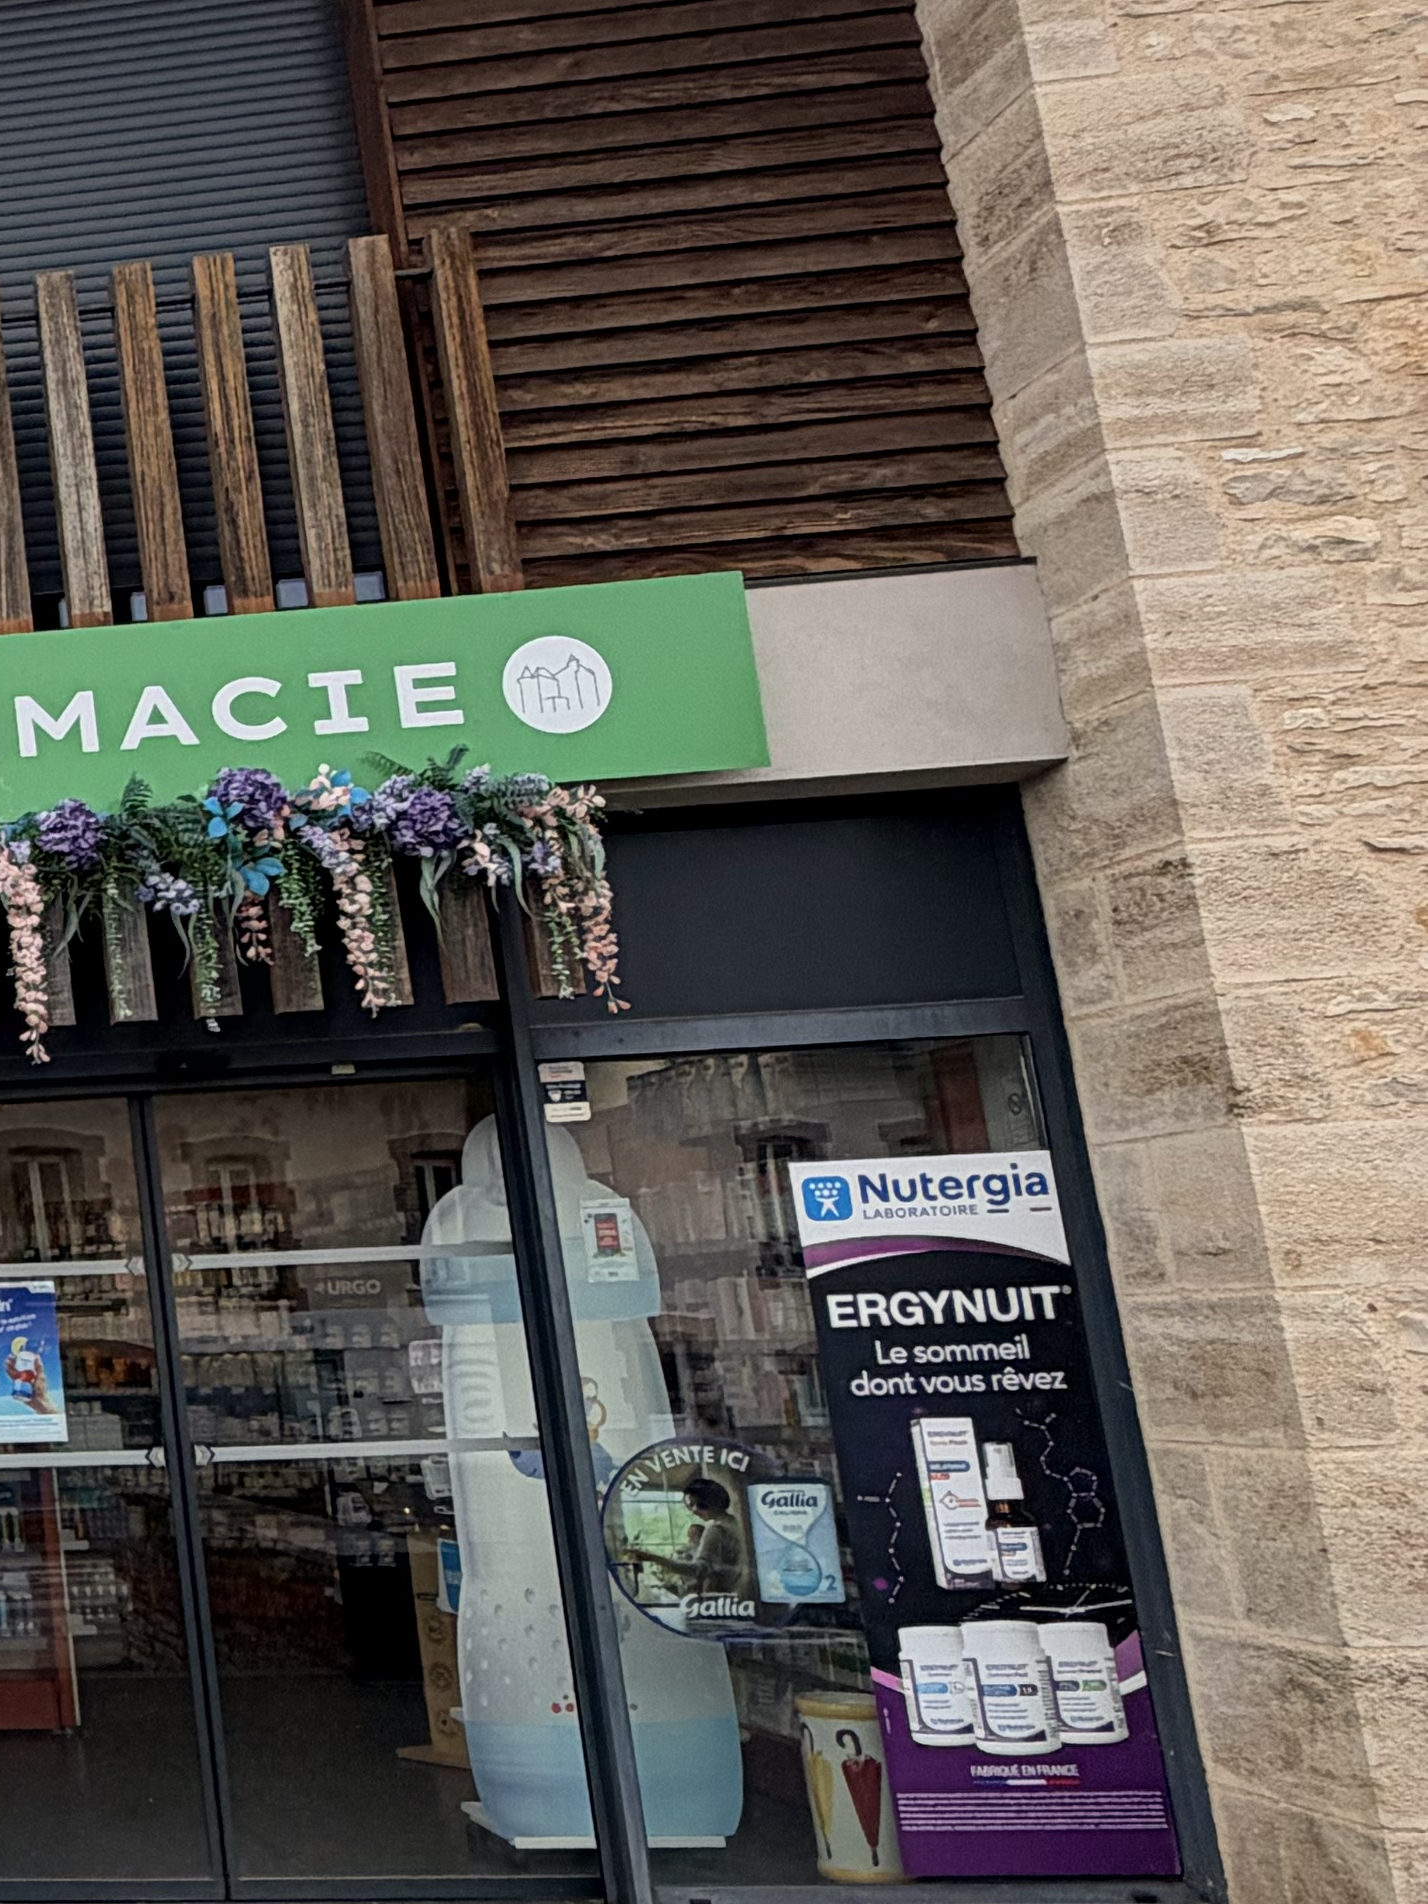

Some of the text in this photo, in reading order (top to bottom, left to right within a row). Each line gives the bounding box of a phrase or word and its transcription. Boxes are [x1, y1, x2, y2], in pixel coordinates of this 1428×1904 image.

[858, 1162, 1050, 1206] Nutergia
[863, 1205, 979, 1220] LABORATOIRE
[326, 1279, 382, 1296] URGO
[875, 1334, 1030, 1365] Le sommeil
[850, 1367, 1068, 1396] dont vous rêvez
[620, 1446, 750, 1497] EN VENTE ICI
[761, 1490, 818, 1508] Gallia
[825, 1574, 837, 1591] 2
[679, 1592, 755, 1618] Gallia
[1021, 1765, 1036, 1776] EN
[1037, 1764, 1079, 1776] FRANCE
